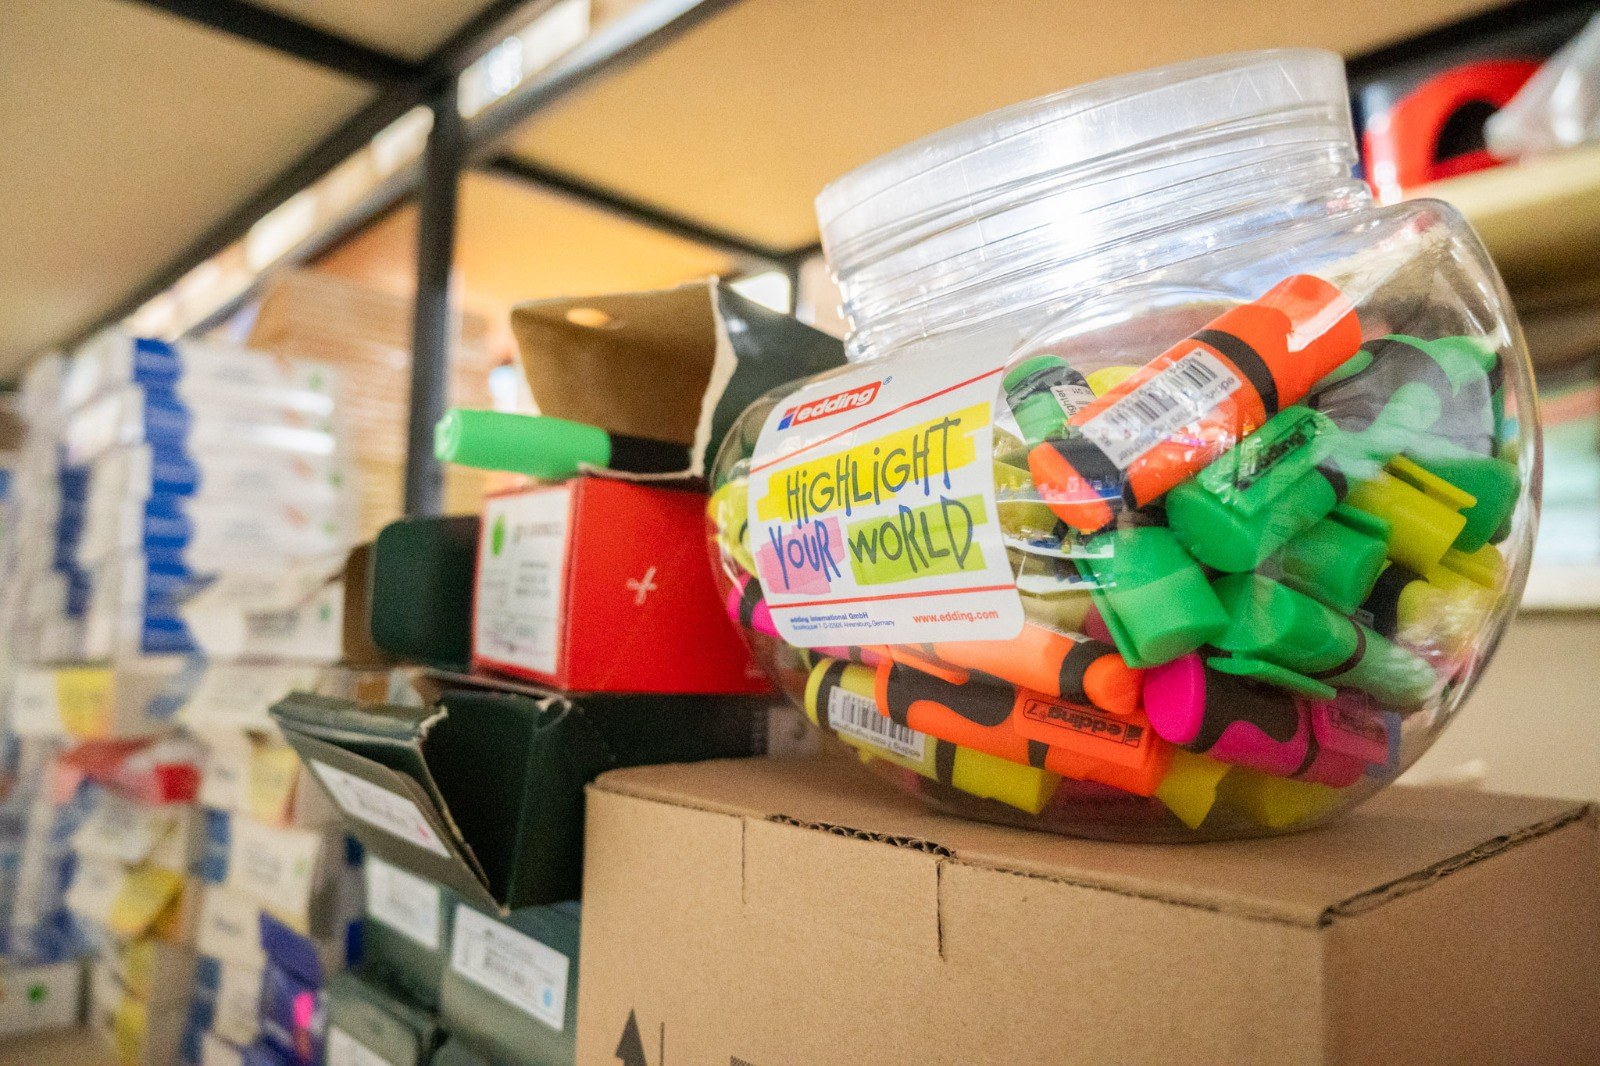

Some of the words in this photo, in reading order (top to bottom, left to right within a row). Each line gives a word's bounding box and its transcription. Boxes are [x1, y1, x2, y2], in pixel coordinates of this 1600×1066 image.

[796, 387, 876, 421] edding
[1055, 389, 1077, 416] lighter
[769, 519, 842, 590] YOUR
[847, 494, 974, 574] WORLD
[849, 611, 869, 620] GmbH
[872, 618, 895, 629] Germany
[912, 609, 999, 624] www.edding.com
[1047, 705, 1122, 735] edding
